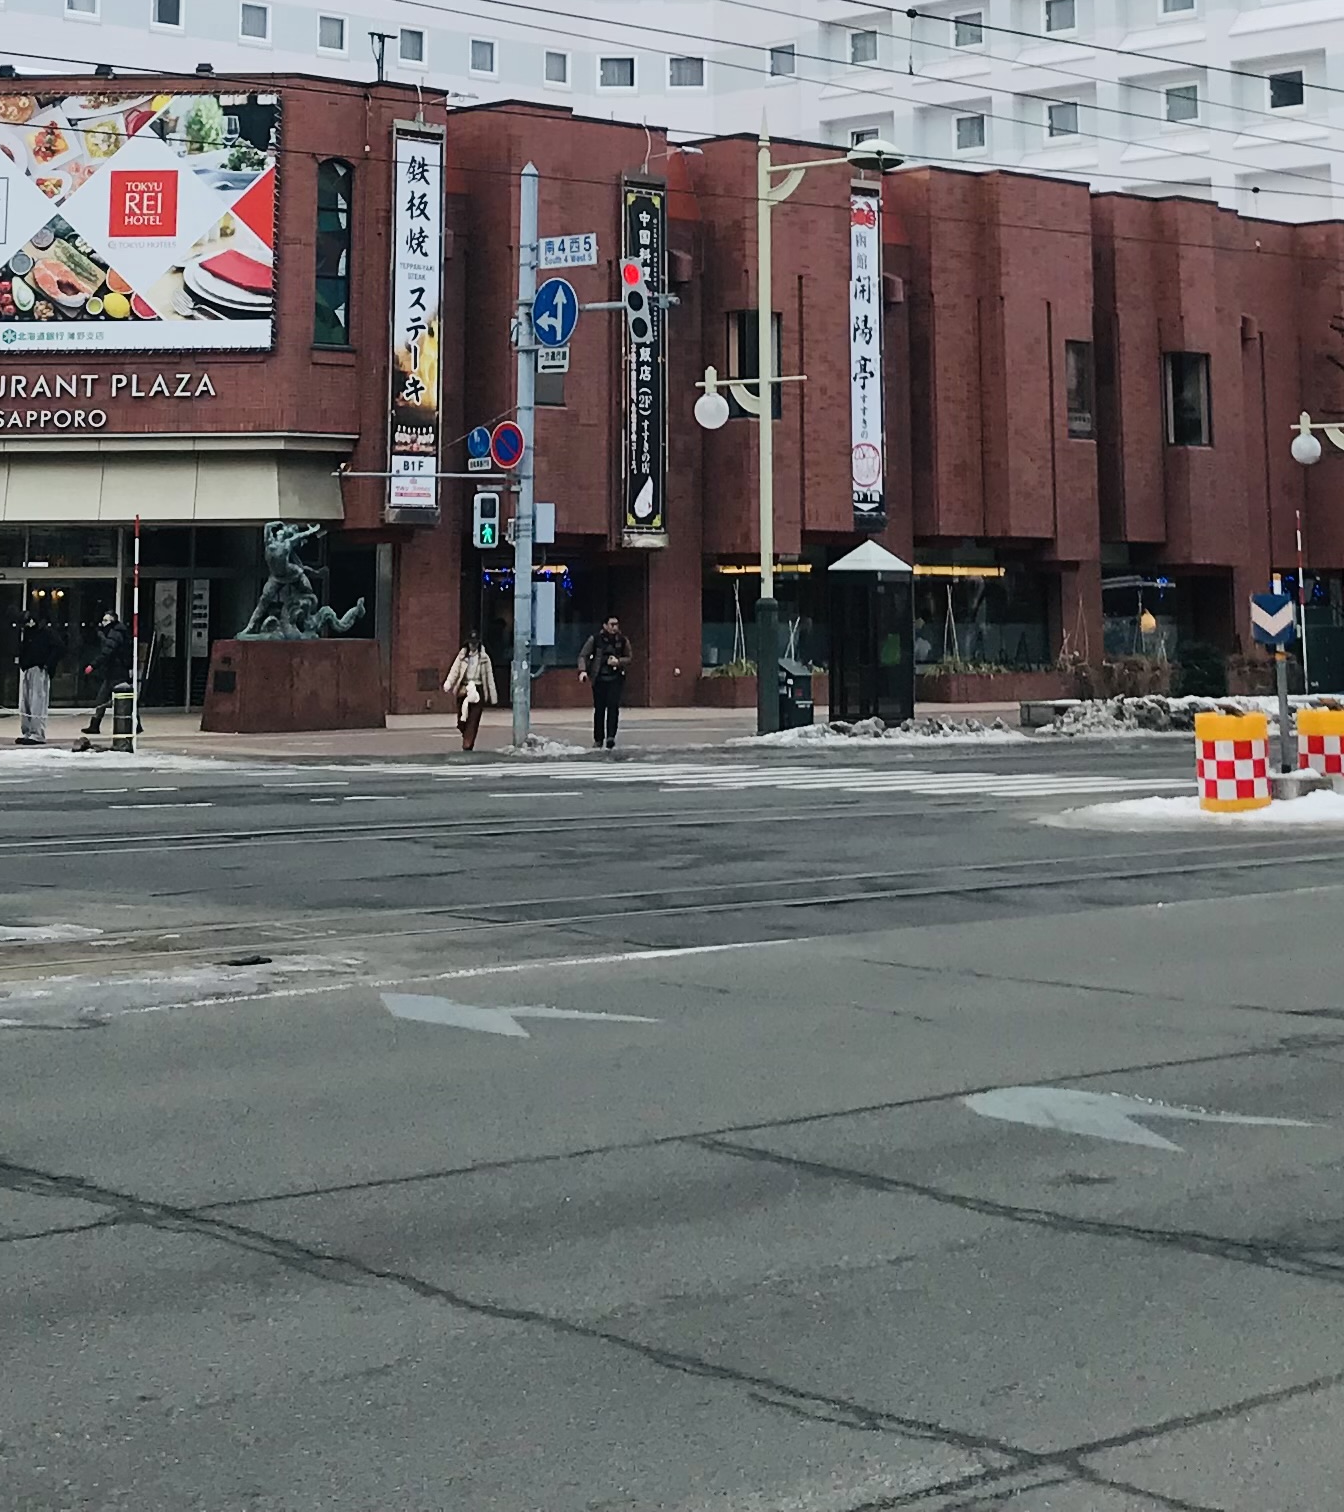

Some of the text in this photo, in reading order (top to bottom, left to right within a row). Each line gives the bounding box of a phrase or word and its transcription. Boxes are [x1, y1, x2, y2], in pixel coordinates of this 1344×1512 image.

[125, 182, 163, 191] TOKYU
[124, 192, 162, 214] REI
[406, 155, 431, 258] 鉄板焼
[124, 215, 163, 226] HOTEL
[407, 272, 426, 281] STEAK
[405, 286, 427, 402] ステーキ
[111, 373, 216, 397] PLAZA
[403, 460, 424, 471] B1F
